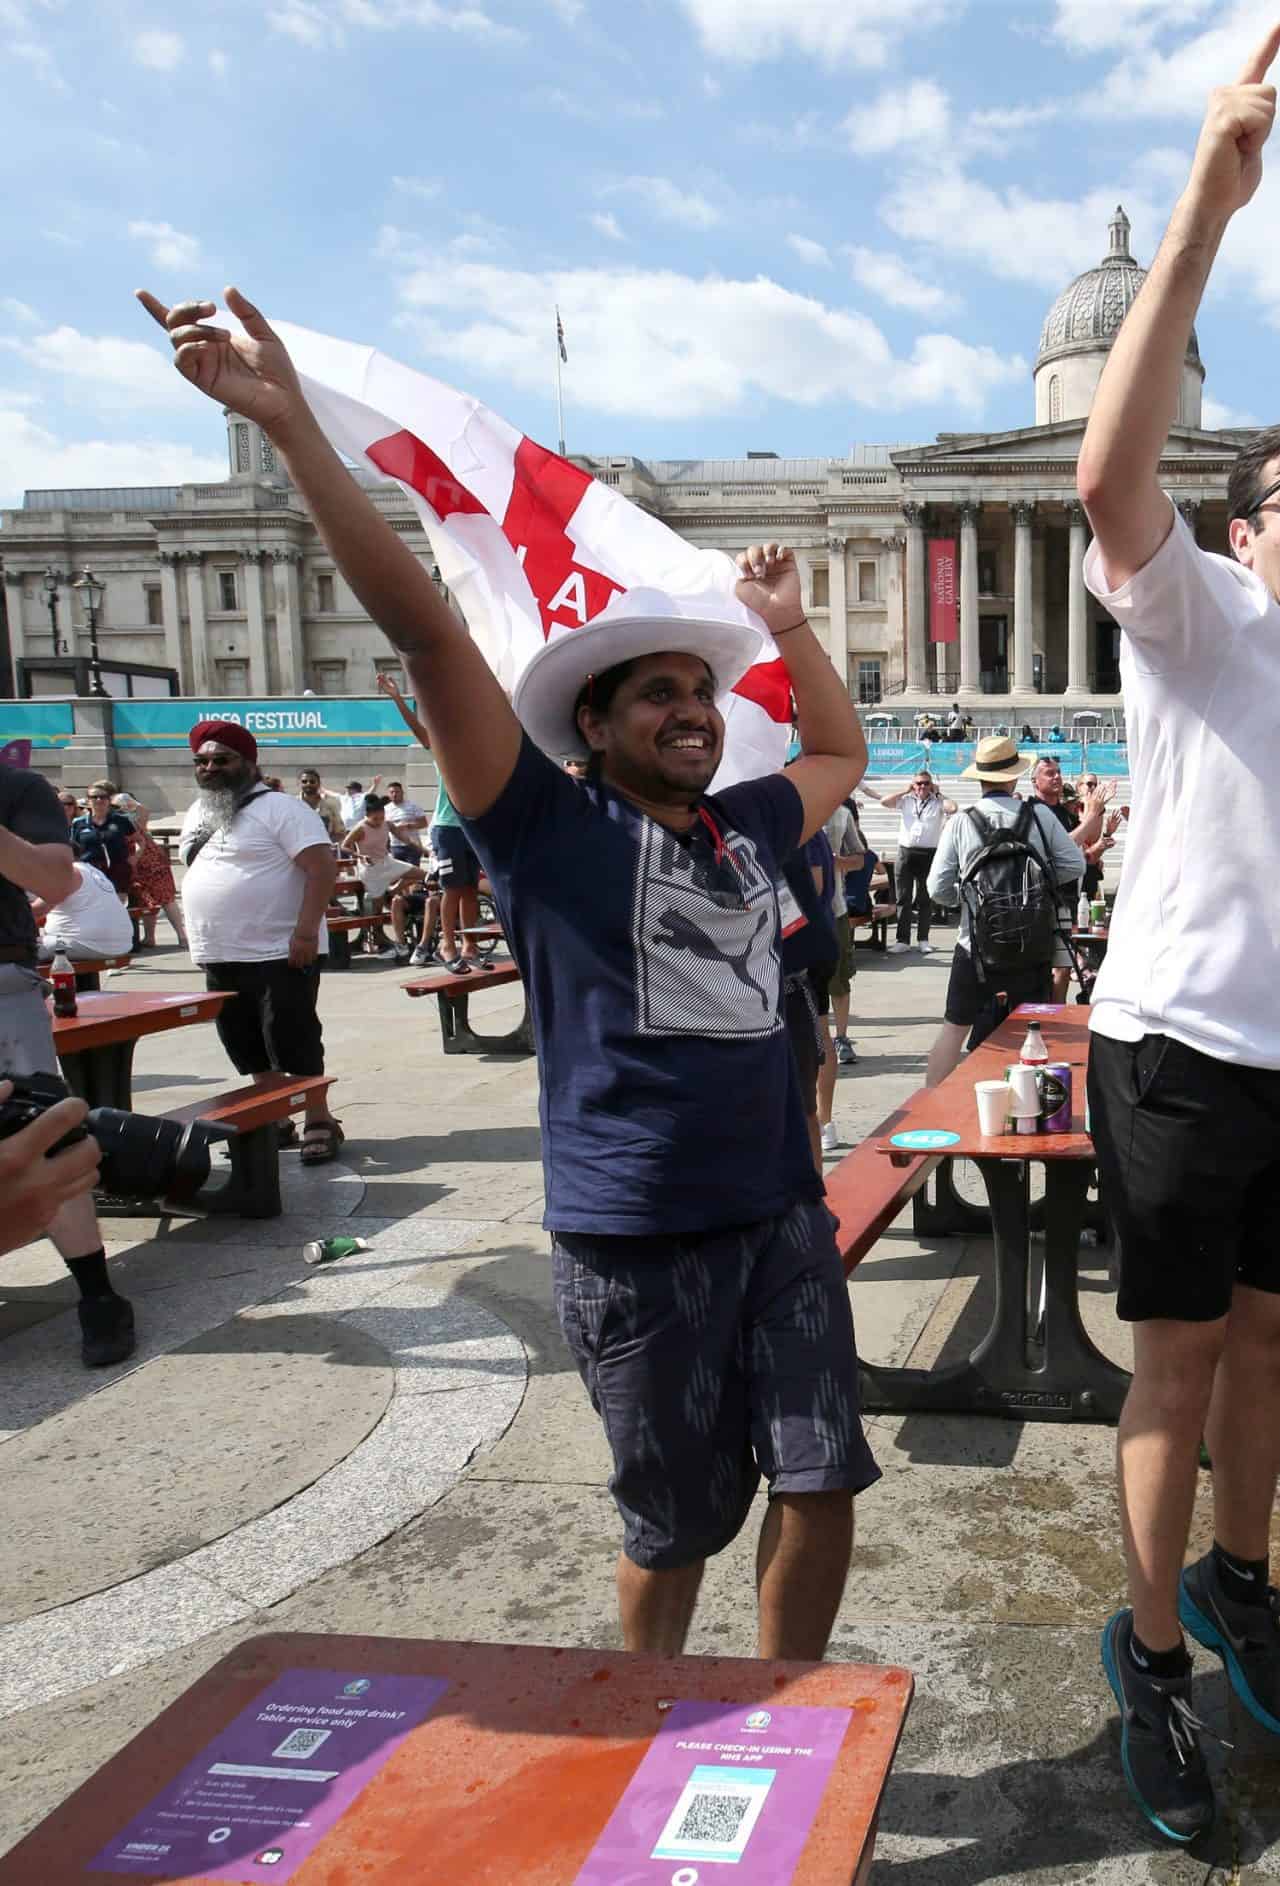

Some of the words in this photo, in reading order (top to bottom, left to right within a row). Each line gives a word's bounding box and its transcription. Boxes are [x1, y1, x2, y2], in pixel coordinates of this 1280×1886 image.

[245, 711, 327, 729] FESTIVAL
[265, 1703, 315, 1715] Ordering
[317, 1706, 344, 1716] food
[345, 1709, 367, 1718] and
[367, 1711, 406, 1720] drink?
[256, 1713, 286, 1723] Table
[287, 1717, 329, 1726] service
[330, 1719, 357, 1729] only
[675, 1741, 713, 1751] PLEASE
[714, 1743, 760, 1753] CHECK-IN
[761, 1746, 792, 1755] USING
[793, 1748, 814, 1757] THE
[720, 1753, 741, 1762] NHS
